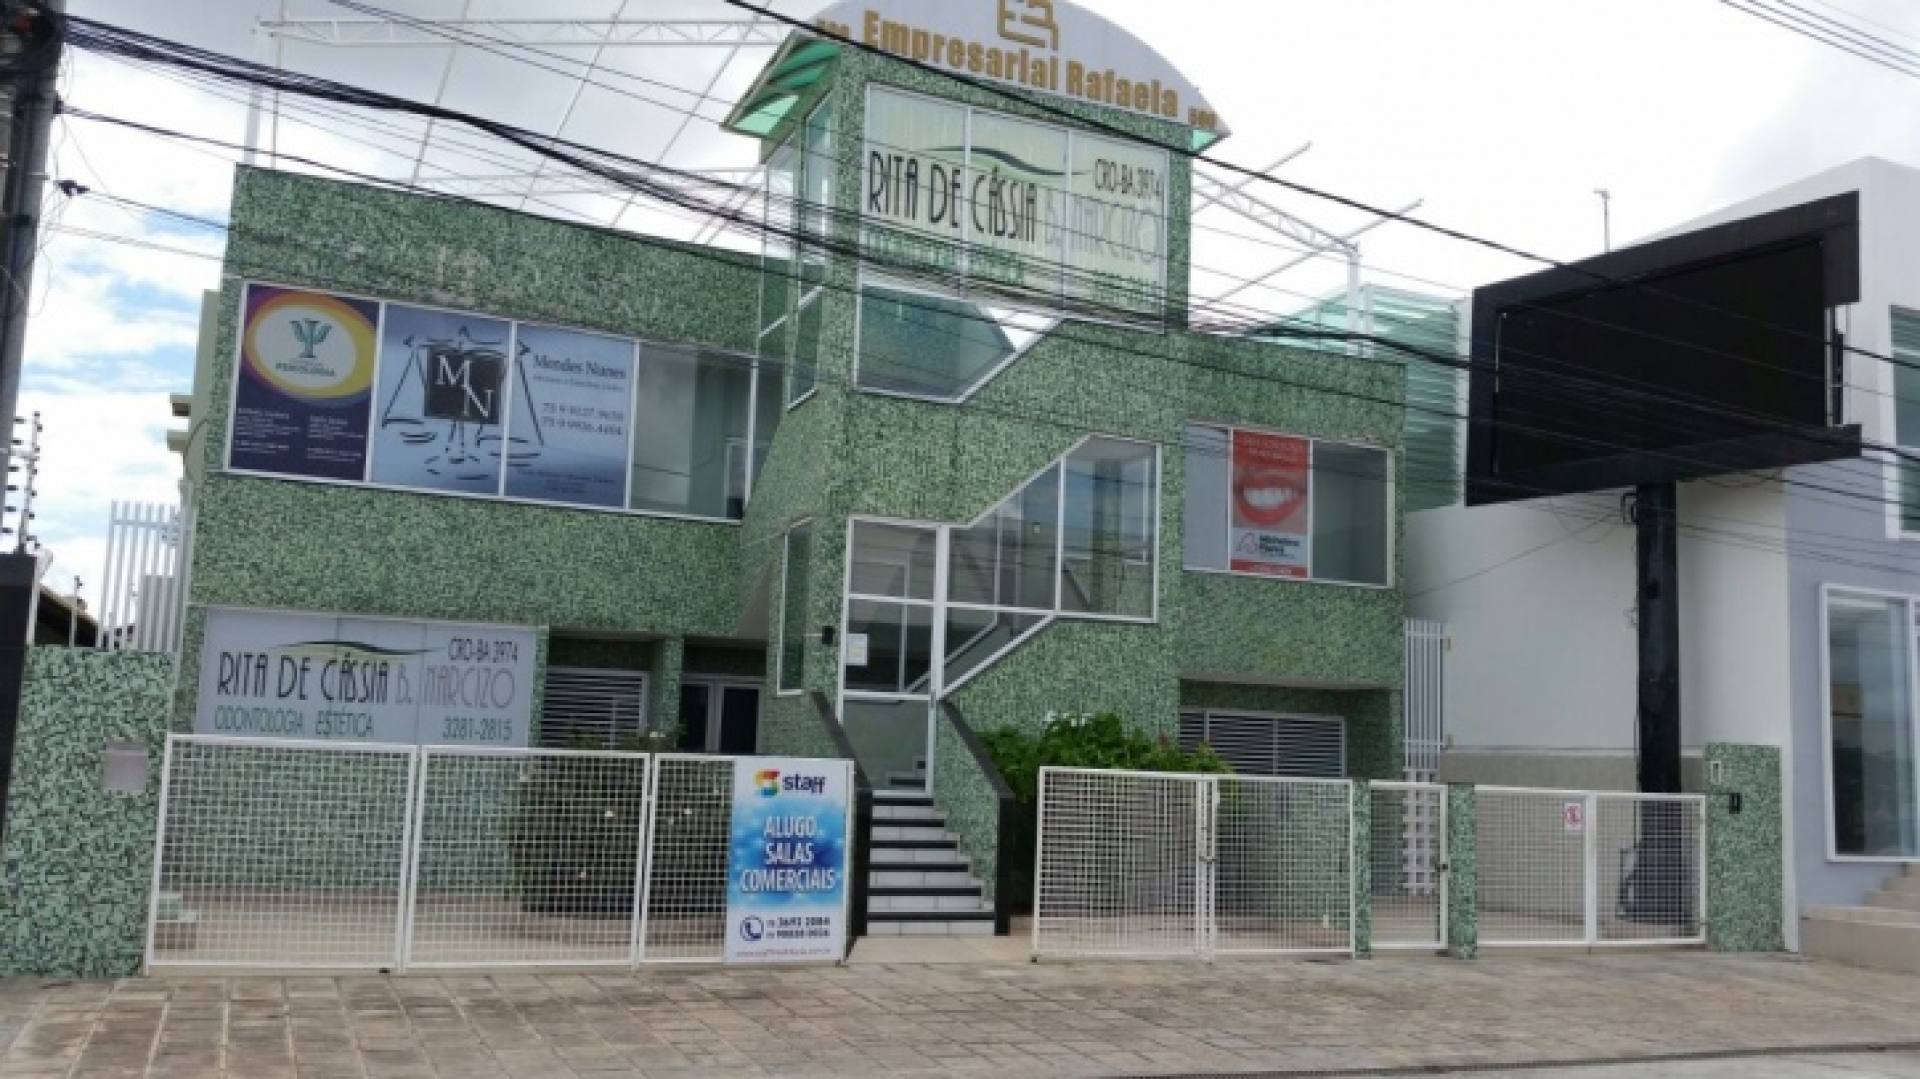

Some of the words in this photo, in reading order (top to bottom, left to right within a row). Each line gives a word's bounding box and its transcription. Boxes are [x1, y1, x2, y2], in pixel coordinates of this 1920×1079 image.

[863, 10, 1059, 90] Empresarial
[1066, 59, 1178, 117] Rafaela
[868, 150, 919, 221] RITA
[929, 162, 961, 229] DE
[971, 166, 1038, 243] CÁSSIA
[533, 353, 584, 373] Mendes
[585, 359, 627, 379] Nunes
[217, 651, 268, 697] RITA
[277, 655, 310, 700] DE
[321, 651, 388, 704] CÁSSIA
[424, 663, 515, 709] NARCIZO
[214, 704, 303, 734] ODONTOLOGIA
[315, 706, 375, 738] ESTÉTICA
[442, 716, 513, 742] 3281-2815
[782, 773, 826, 794] staff
[764, 815, 818, 838] ALUGO
[766, 842, 815, 866] SALAS
[740, 868, 836, 893] COMERCIAIS
